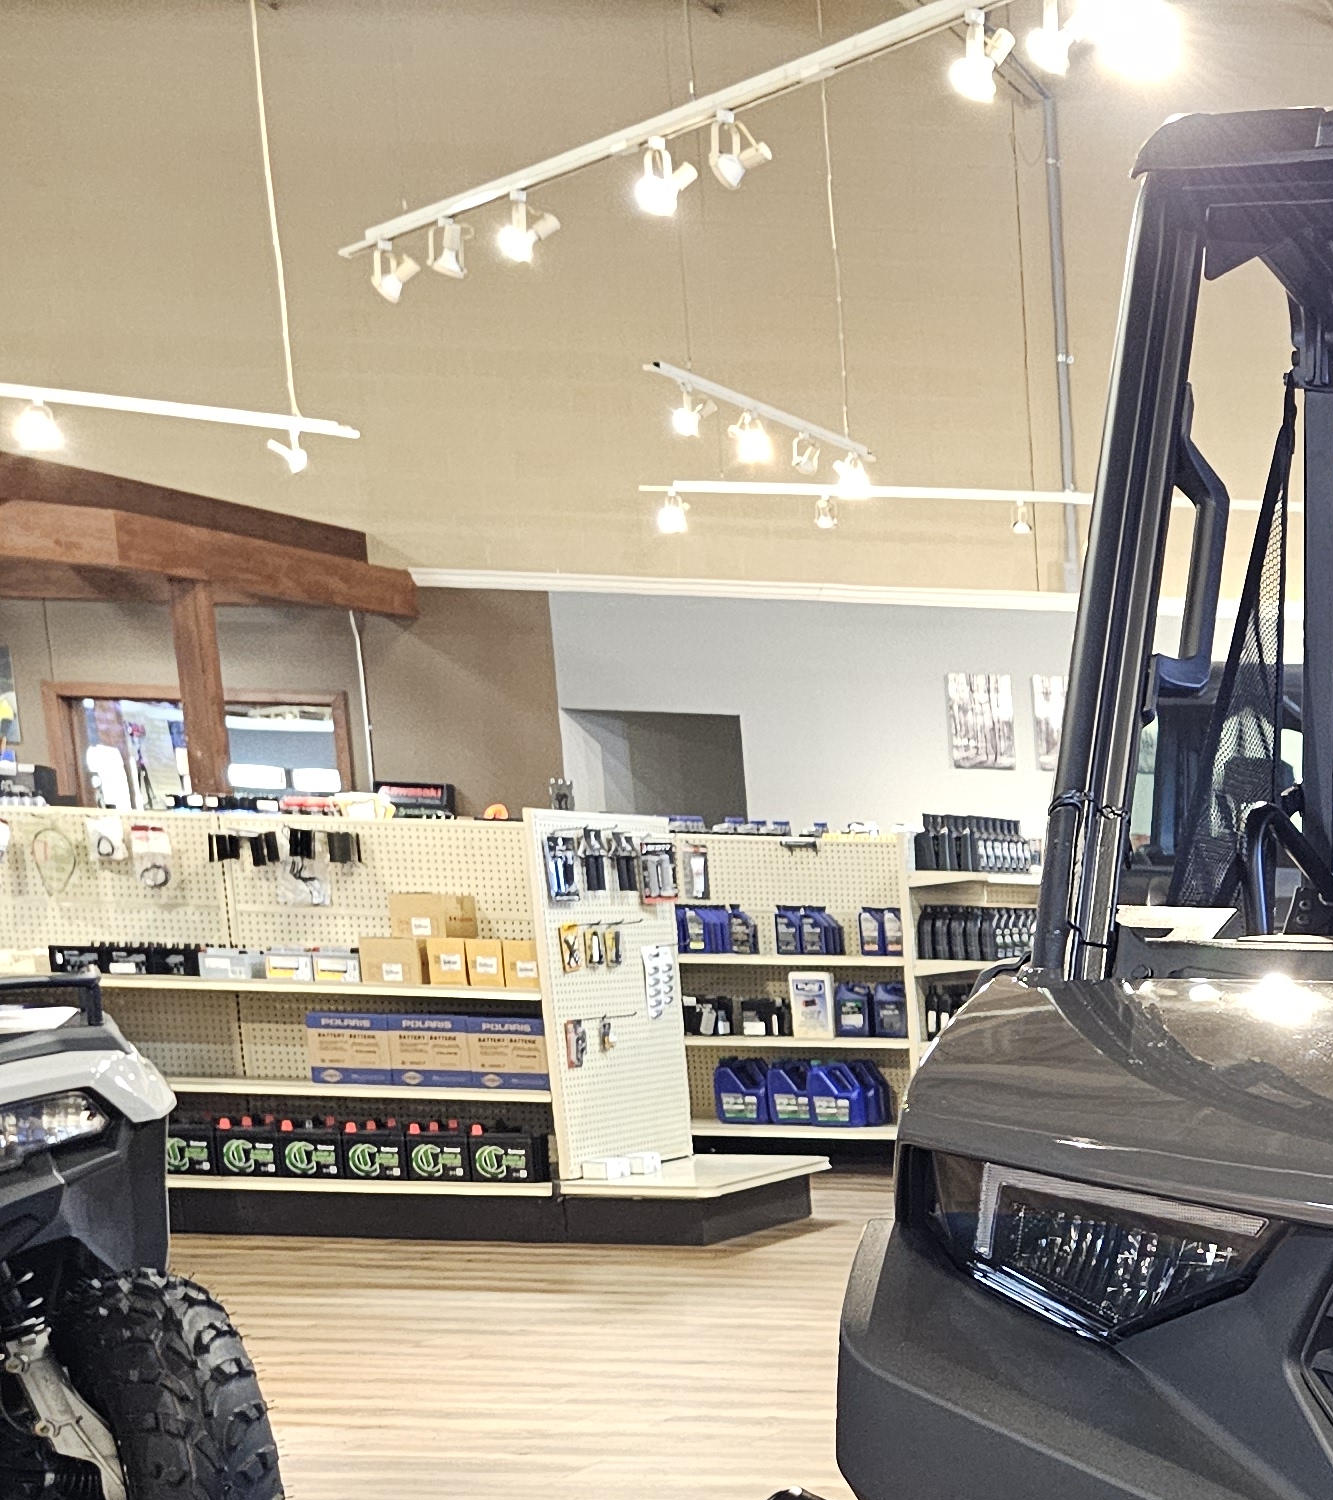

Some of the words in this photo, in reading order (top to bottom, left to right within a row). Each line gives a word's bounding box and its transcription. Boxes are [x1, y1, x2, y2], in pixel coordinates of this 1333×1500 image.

[321, 1018, 371, 1028] POLARIS
[402, 1019, 452, 1029] POLARIS
[481, 1022, 532, 1032] POLARIS
